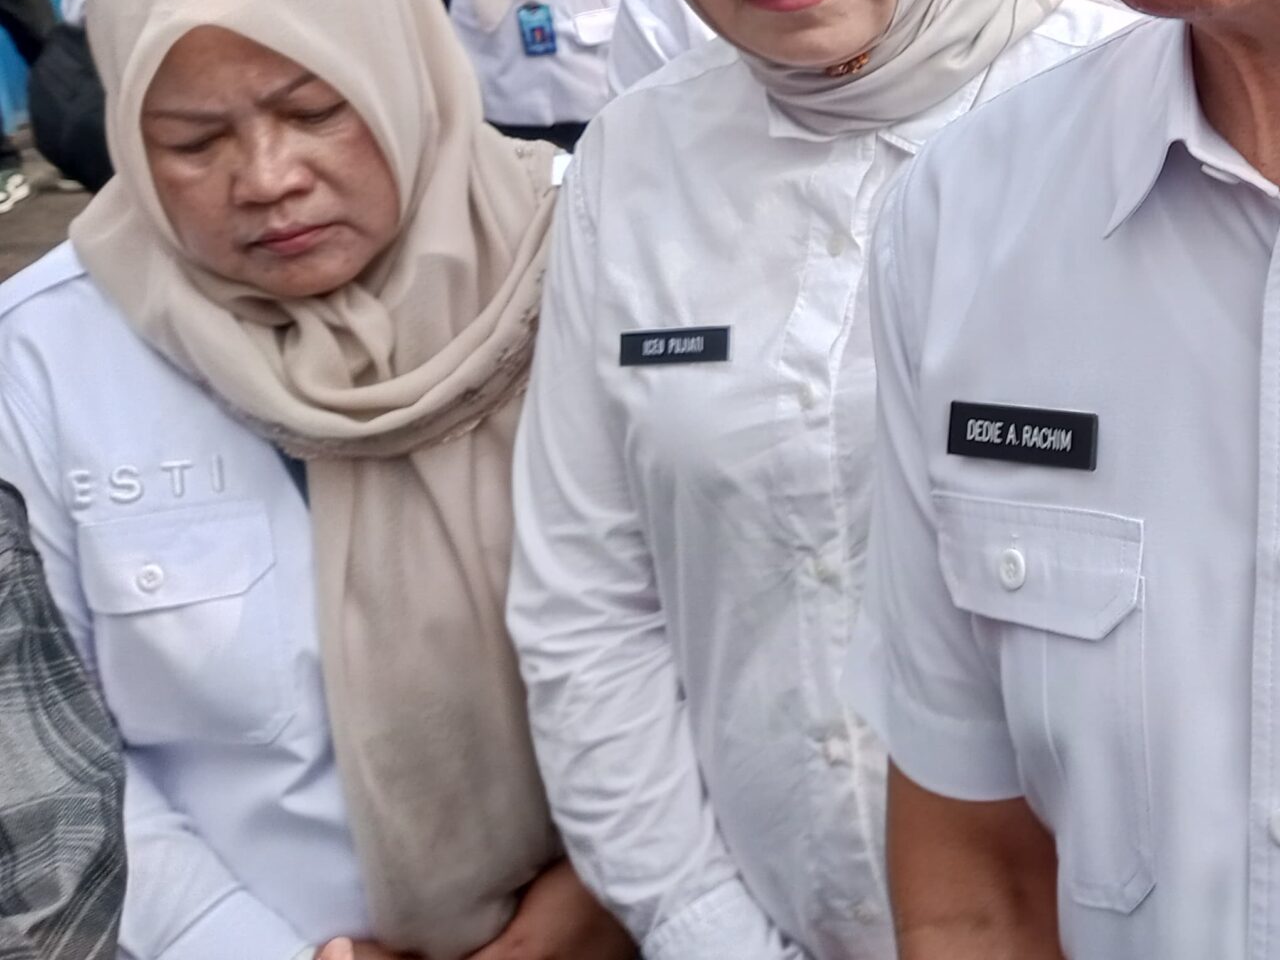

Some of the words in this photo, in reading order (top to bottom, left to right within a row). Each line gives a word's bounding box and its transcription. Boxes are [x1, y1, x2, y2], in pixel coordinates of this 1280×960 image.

[966, 418, 1003, 444] DEDIE
[1021, 425, 1073, 453] RACHIM
[68, 453, 227, 511] ESTI
